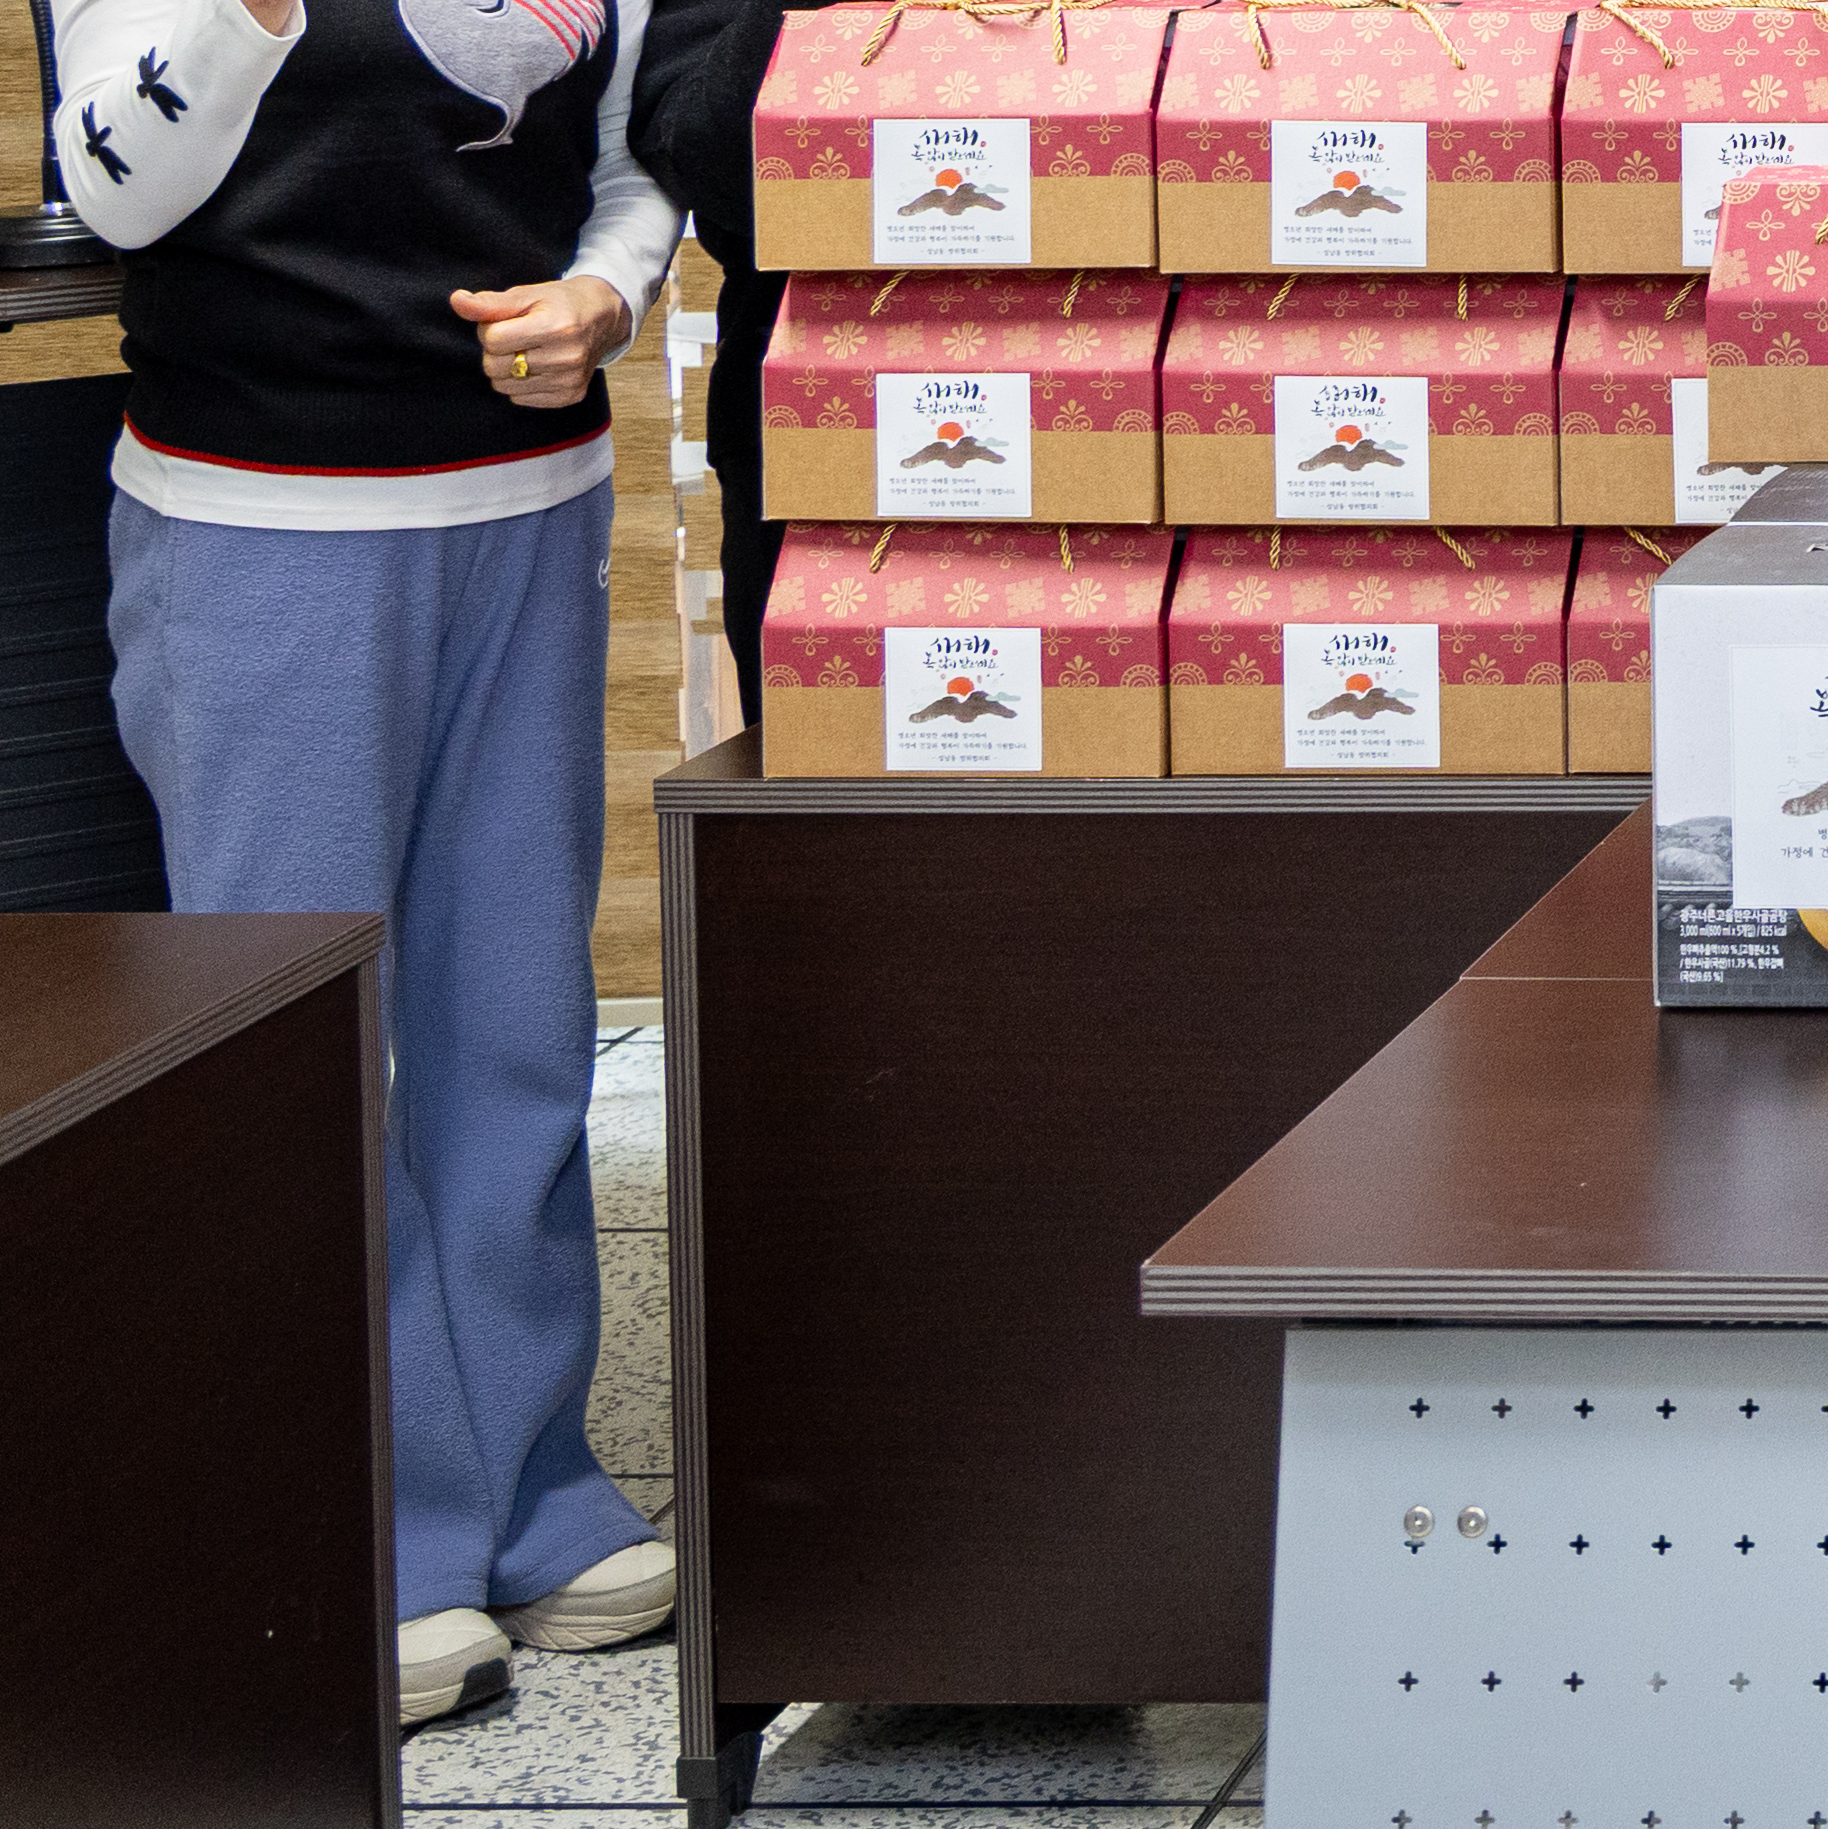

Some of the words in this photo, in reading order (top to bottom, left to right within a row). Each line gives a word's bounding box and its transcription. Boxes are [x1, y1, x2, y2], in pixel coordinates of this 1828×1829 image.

[920, 127, 979, 146] 새해
[1317, 129, 1376, 148] 새해
[1727, 131, 1786, 150] 새해
[922, 381, 980, 399] 새해
[931, 635, 990, 654] 새해
[1330, 632, 1389, 651] 새해
[1781, 847, 1813, 857] 가정에
